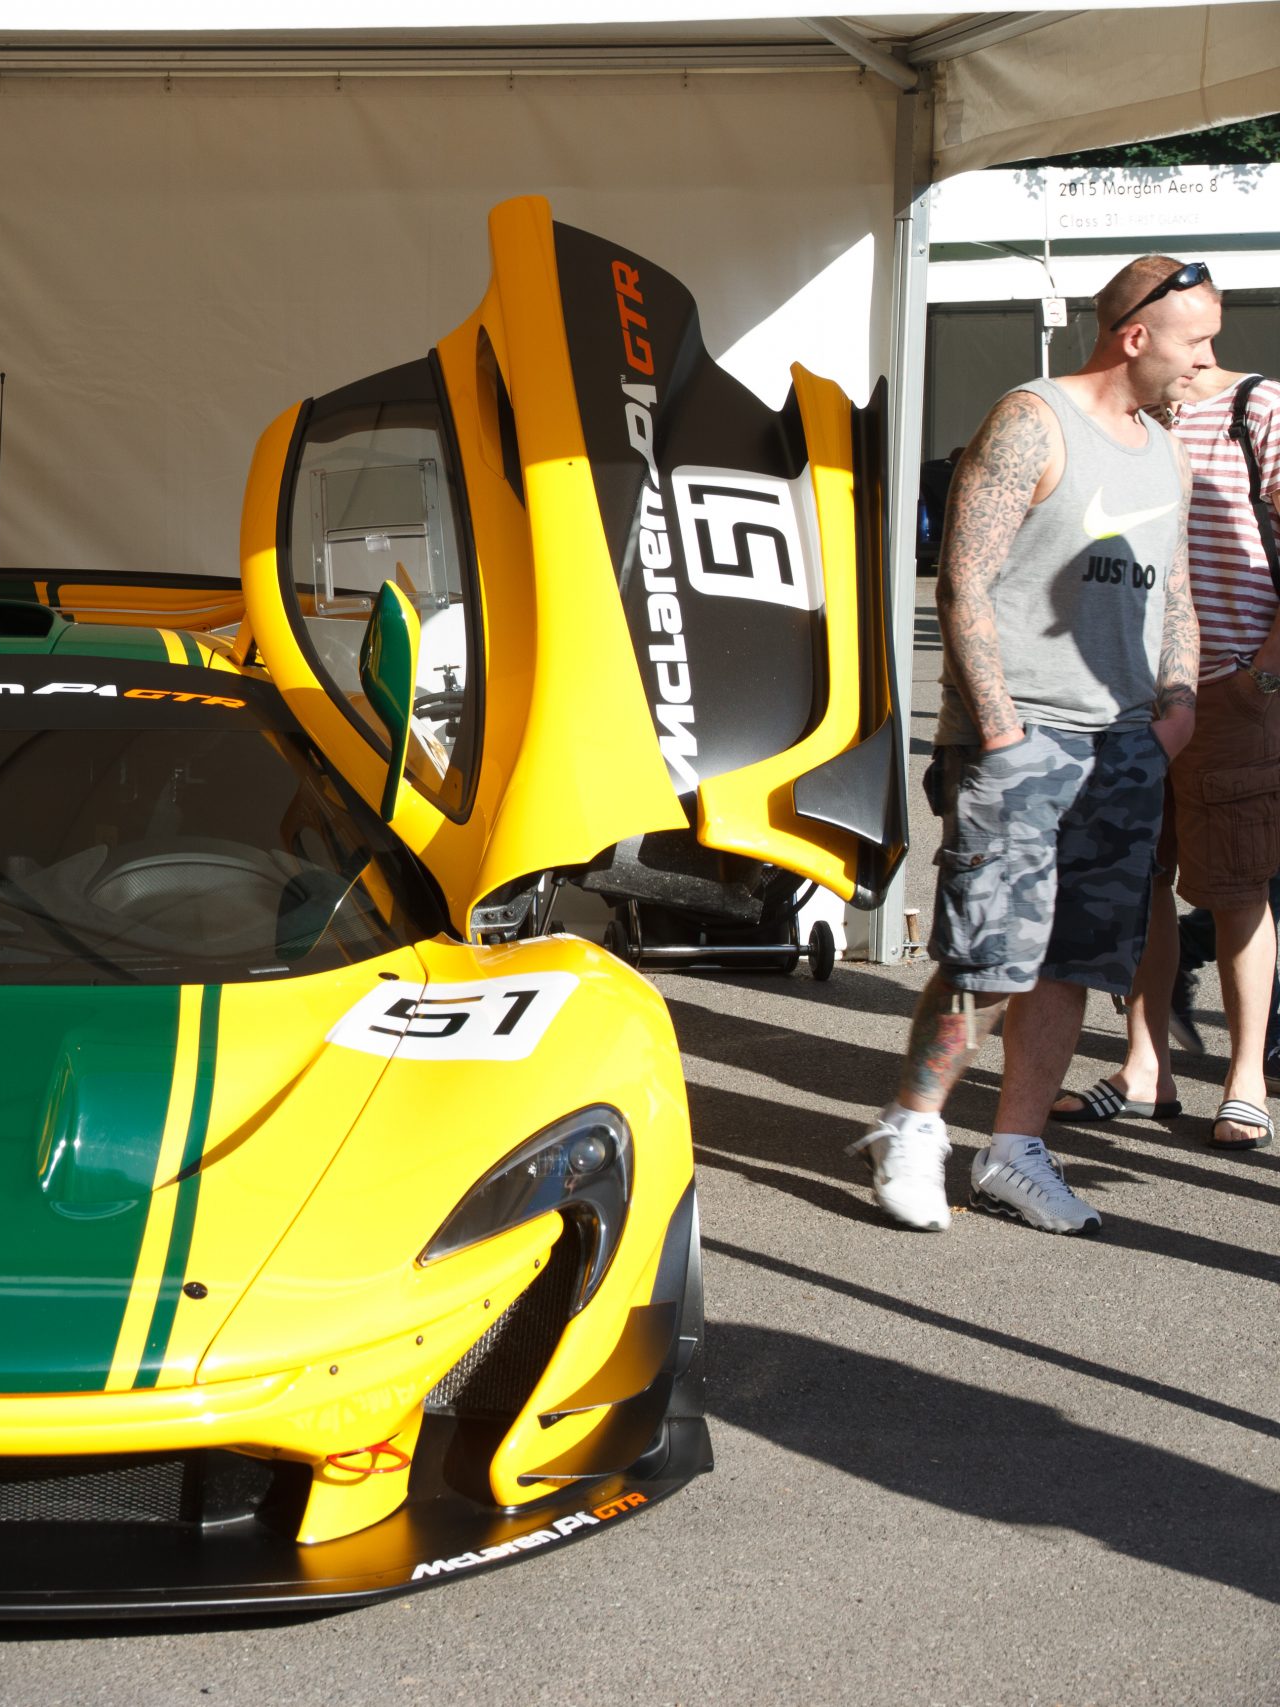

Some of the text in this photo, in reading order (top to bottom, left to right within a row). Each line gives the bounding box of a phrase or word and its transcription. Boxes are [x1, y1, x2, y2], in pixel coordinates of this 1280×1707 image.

[1059, 178, 1218, 198] 2015 Morgan Aero 8
[1059, 213, 1098, 228] Class
[611, 260, 655, 376] GTR
[687, 483, 795, 587] 51
[1082, 555, 1128, 585] JUST
[1132, 561, 1156, 590] DO
[639, 485, 700, 792] McLaren
[32, 681, 118, 697] P1
[123, 688, 247, 709] GTR
[368, 989, 540, 1038] 51
[411, 1530, 561, 1580] McLaren
[592, 1492, 648, 1521] GTR
